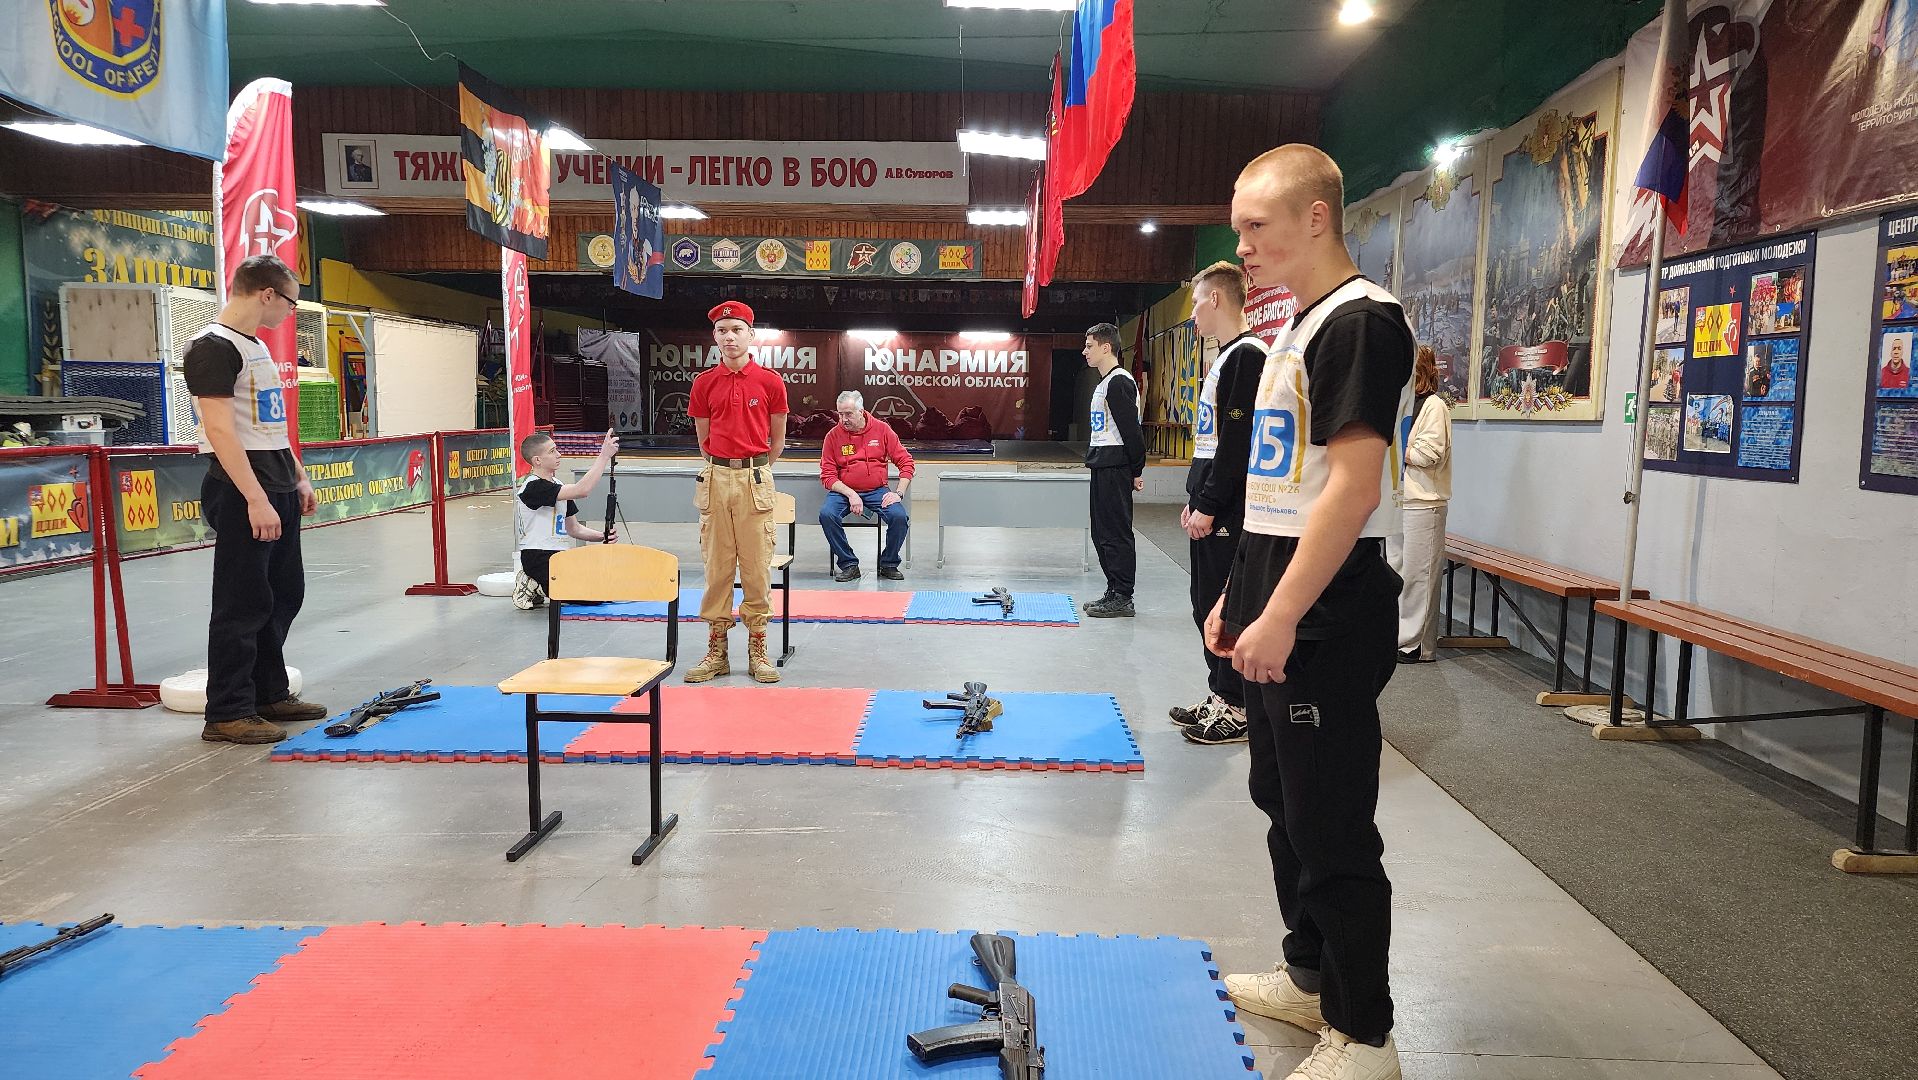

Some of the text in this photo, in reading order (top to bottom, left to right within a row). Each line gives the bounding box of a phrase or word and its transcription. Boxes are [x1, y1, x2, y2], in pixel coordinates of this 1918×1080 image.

[1857, 107, 1912, 132] ТЕРРИТОРИЯ
[394, 150, 466, 182] ТЯЖ
[687, 155, 773, 187] ЛЕГКО
[783, 157, 800, 187] В
[810, 157, 878, 188] БОЮ
[1715, 248, 1760, 271] ПОДГОТОВКИ
[1761, 238, 1807, 261] МОЛОДЕЖИ
[650, 344, 817, 370] ЮНАМИЯ
[864, 347, 1030, 373] ЮНАРМИЯ
[864, 373, 1029, 388] МОСКОВСКОЙ ОБЛАСТИ
[303, 461, 355, 481] СТРАЦИЯ
[314, 482, 363, 505] ОДСКОГО
